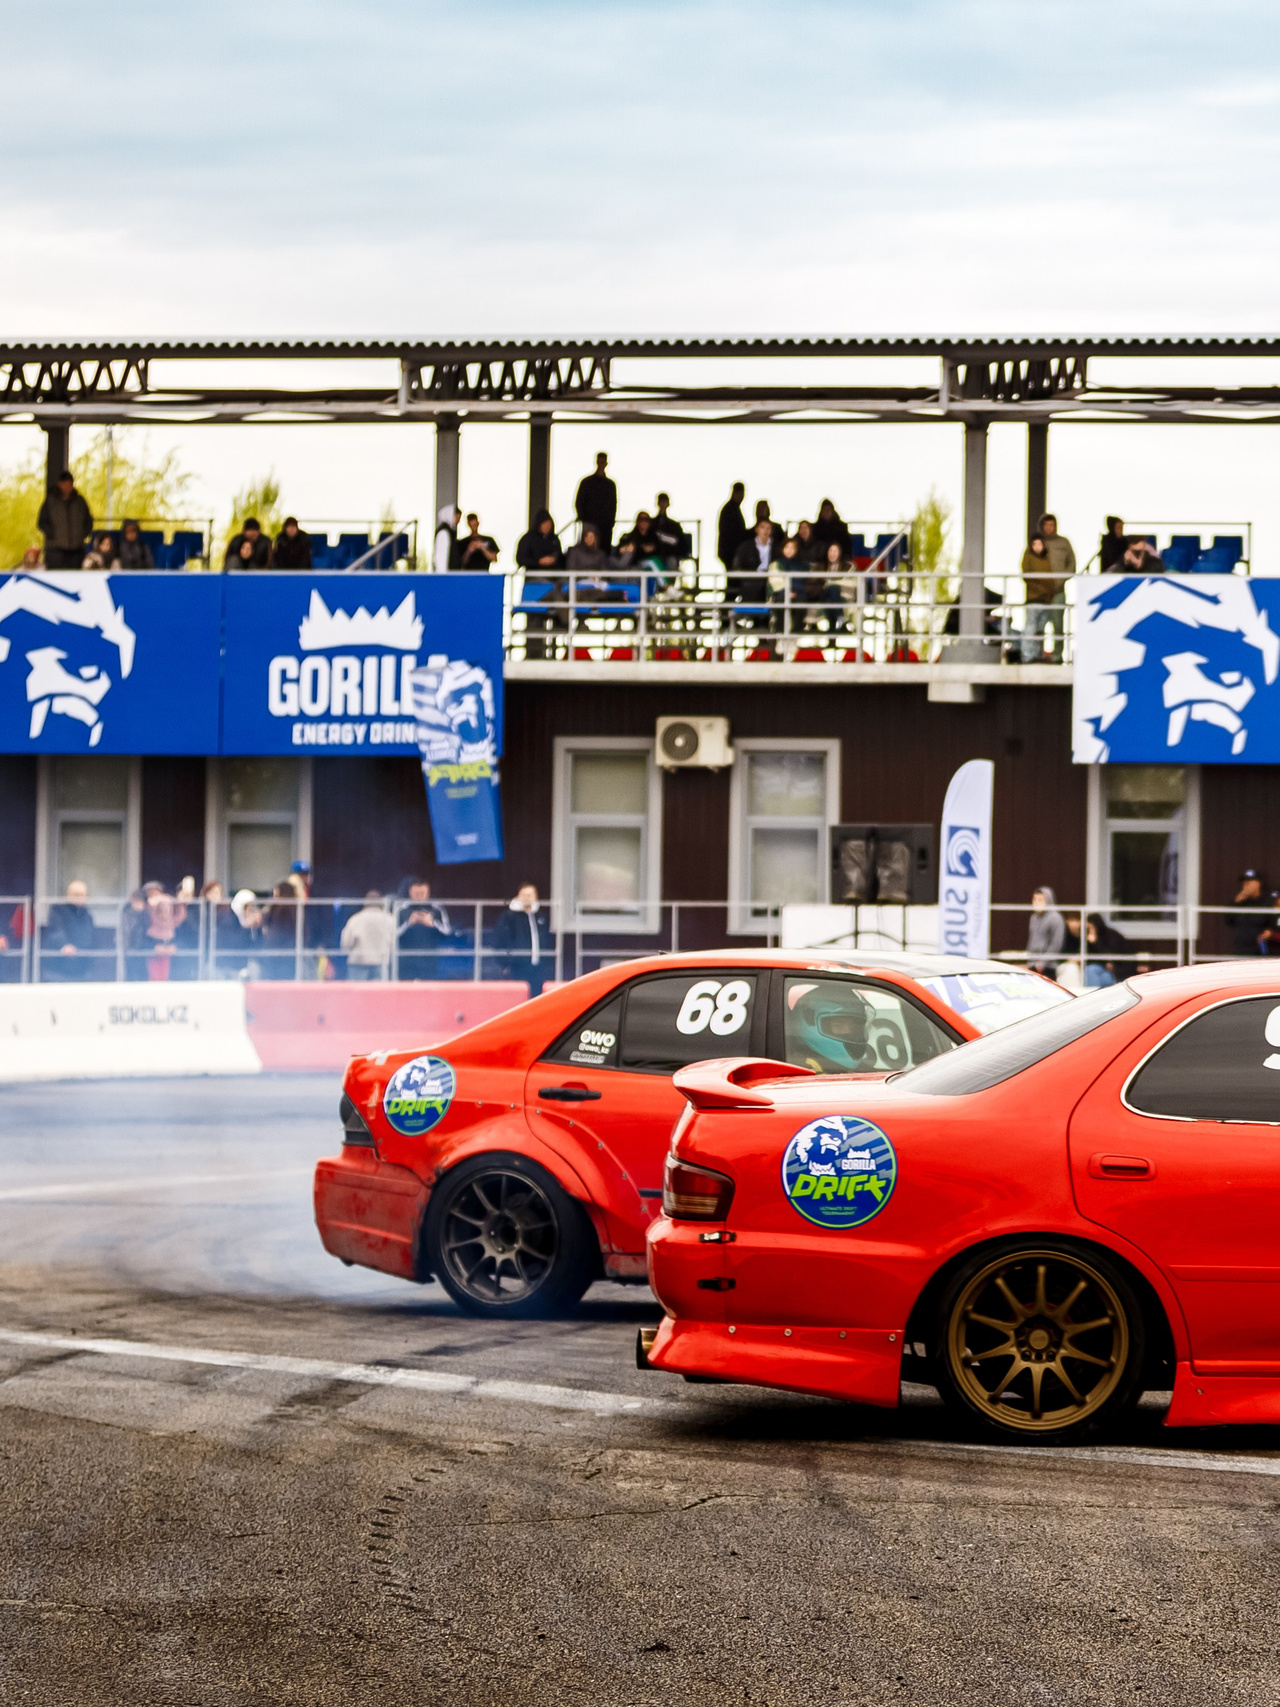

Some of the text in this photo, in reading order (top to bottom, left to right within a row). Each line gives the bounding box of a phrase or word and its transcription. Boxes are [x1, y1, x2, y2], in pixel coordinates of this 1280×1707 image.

[268, 654, 449, 716] GORILL
[292, 722, 418, 745] ENERGY DRIN
[676, 980, 751, 1036] 68
[388, 1097, 446, 1117] DRIFT
[842, 1159, 876, 1170] GORILLA
[791, 1174, 887, 1202] DRIFT
